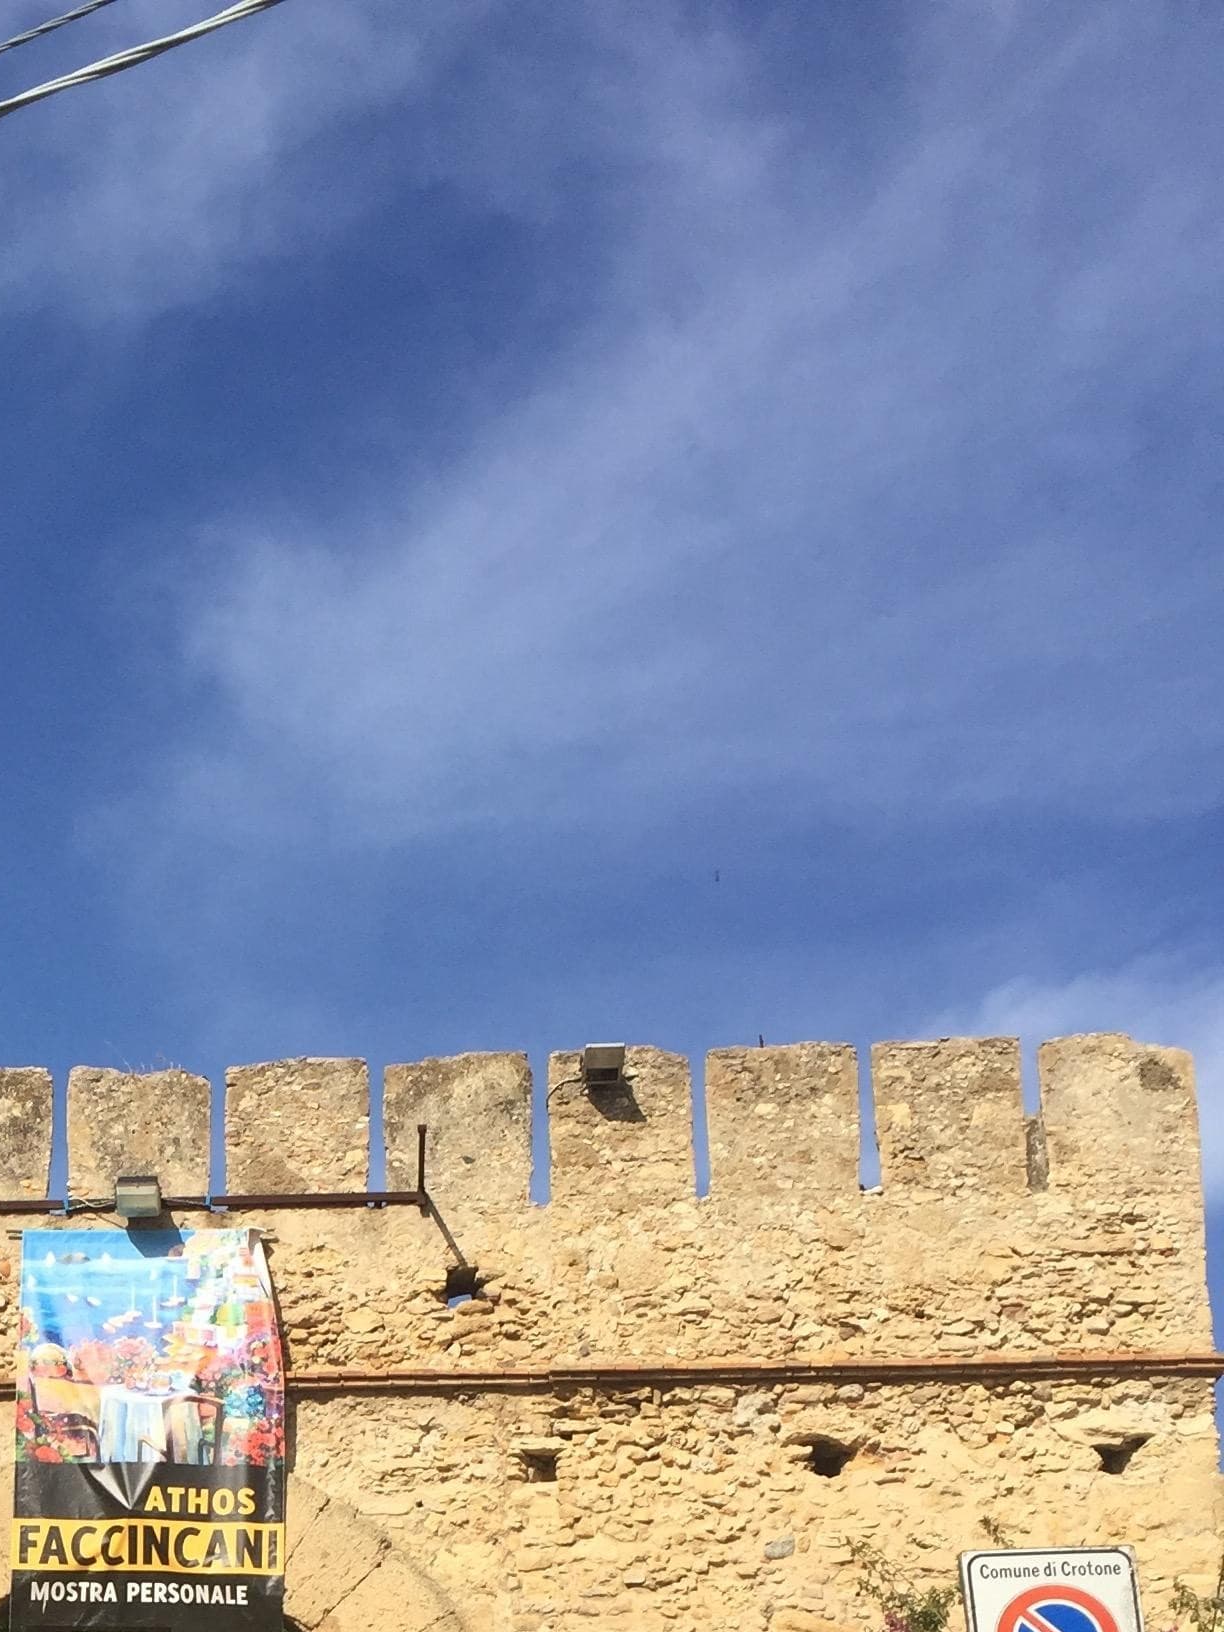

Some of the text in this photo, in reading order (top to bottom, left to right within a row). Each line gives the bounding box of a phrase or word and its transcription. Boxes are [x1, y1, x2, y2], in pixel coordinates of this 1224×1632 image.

[144, 1486, 255, 1515] ATHOS
[19, 1525, 278, 1569] FACCINCANI
[980, 1561, 1122, 1580] Comune di Crotone
[30, 1581, 248, 1606] MOSTRA PERSONALE
